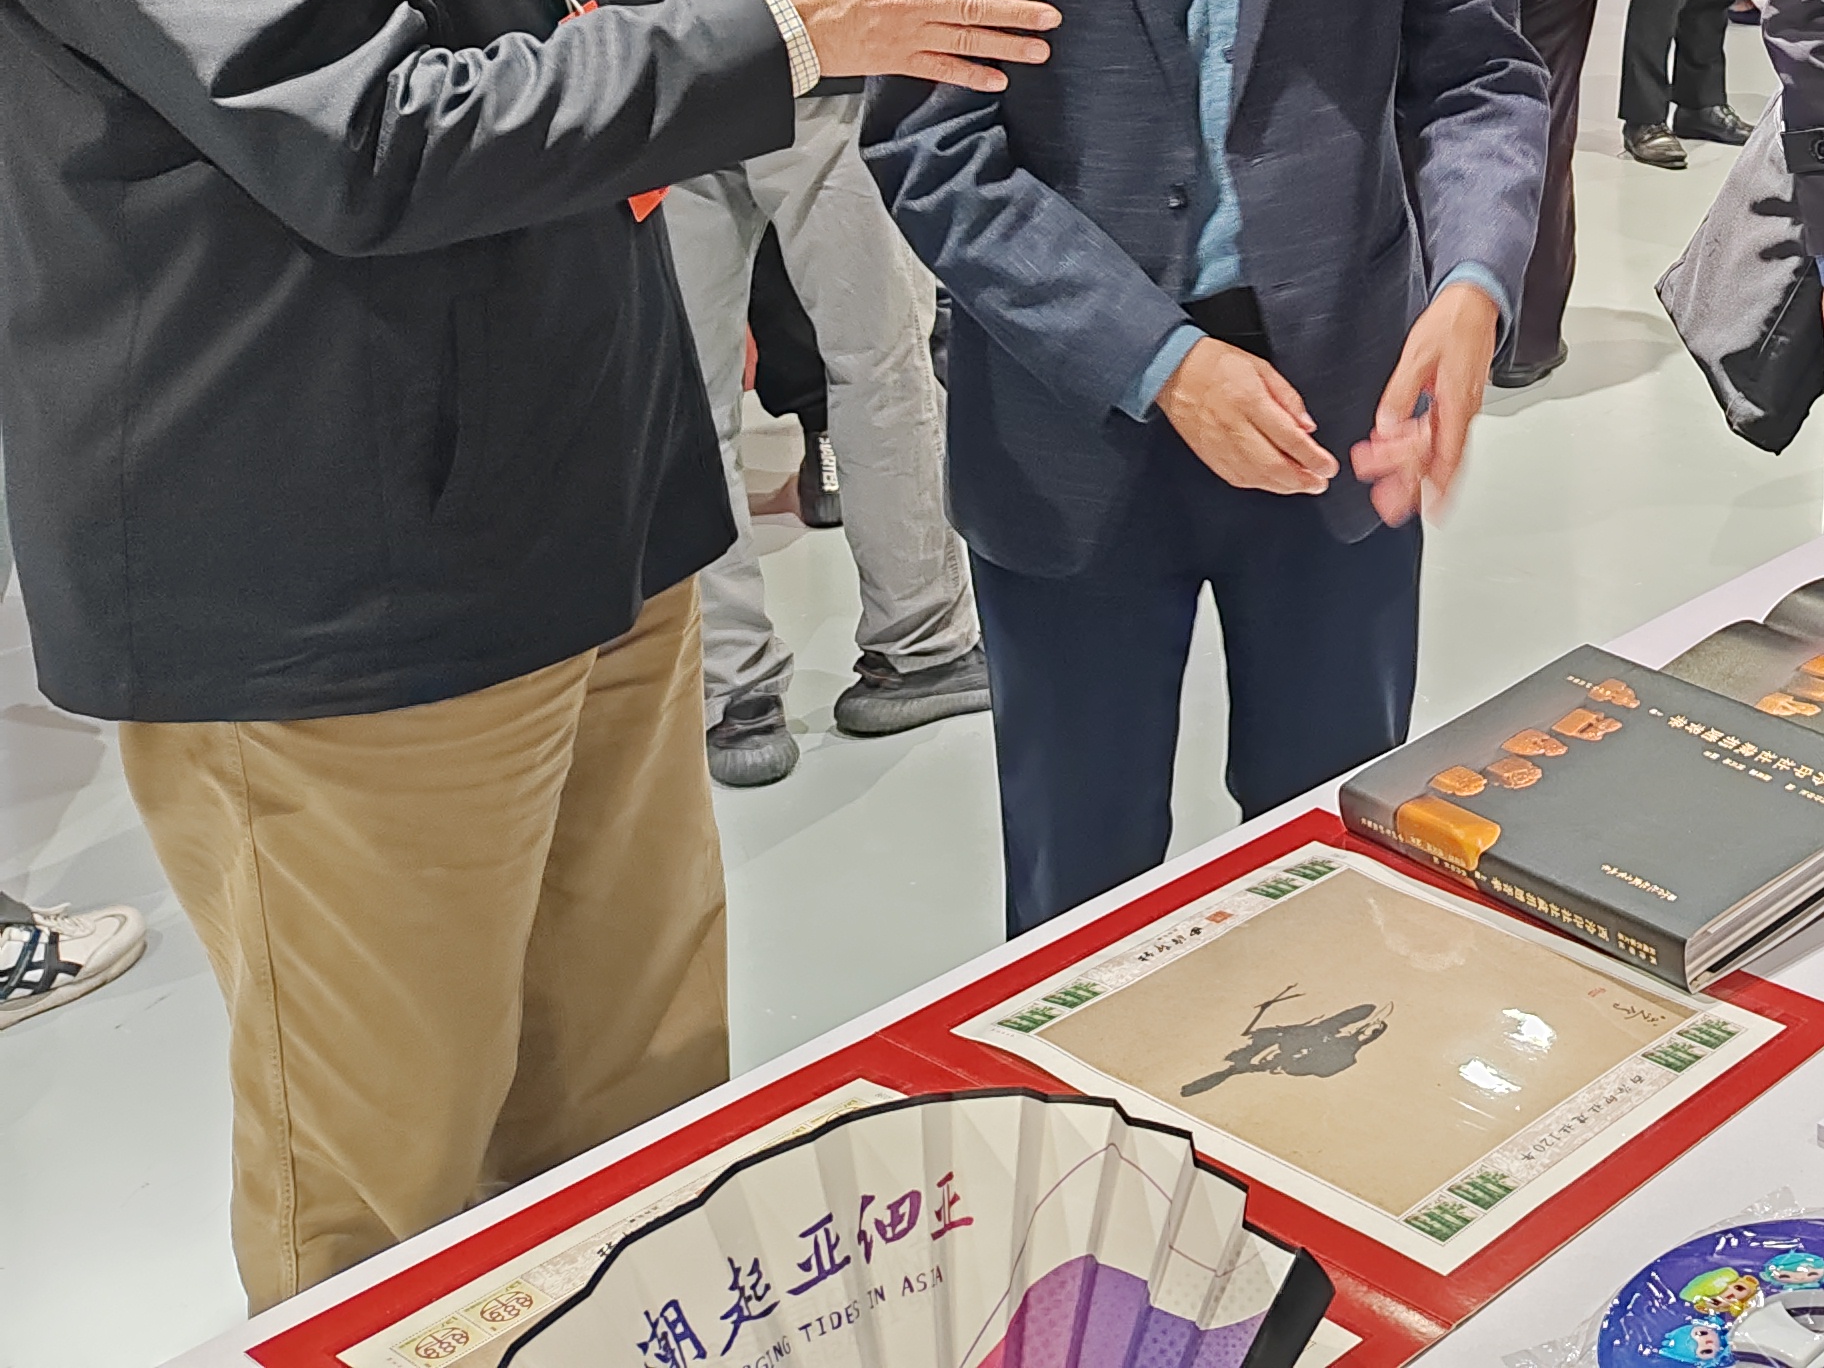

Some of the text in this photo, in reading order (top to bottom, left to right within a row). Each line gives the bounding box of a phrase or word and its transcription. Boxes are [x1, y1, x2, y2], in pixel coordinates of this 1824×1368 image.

[798, 1299, 862, 1344] TIDES
[866, 1284, 887, 1310] IN
[901, 1264, 944, 1296] ASIA
